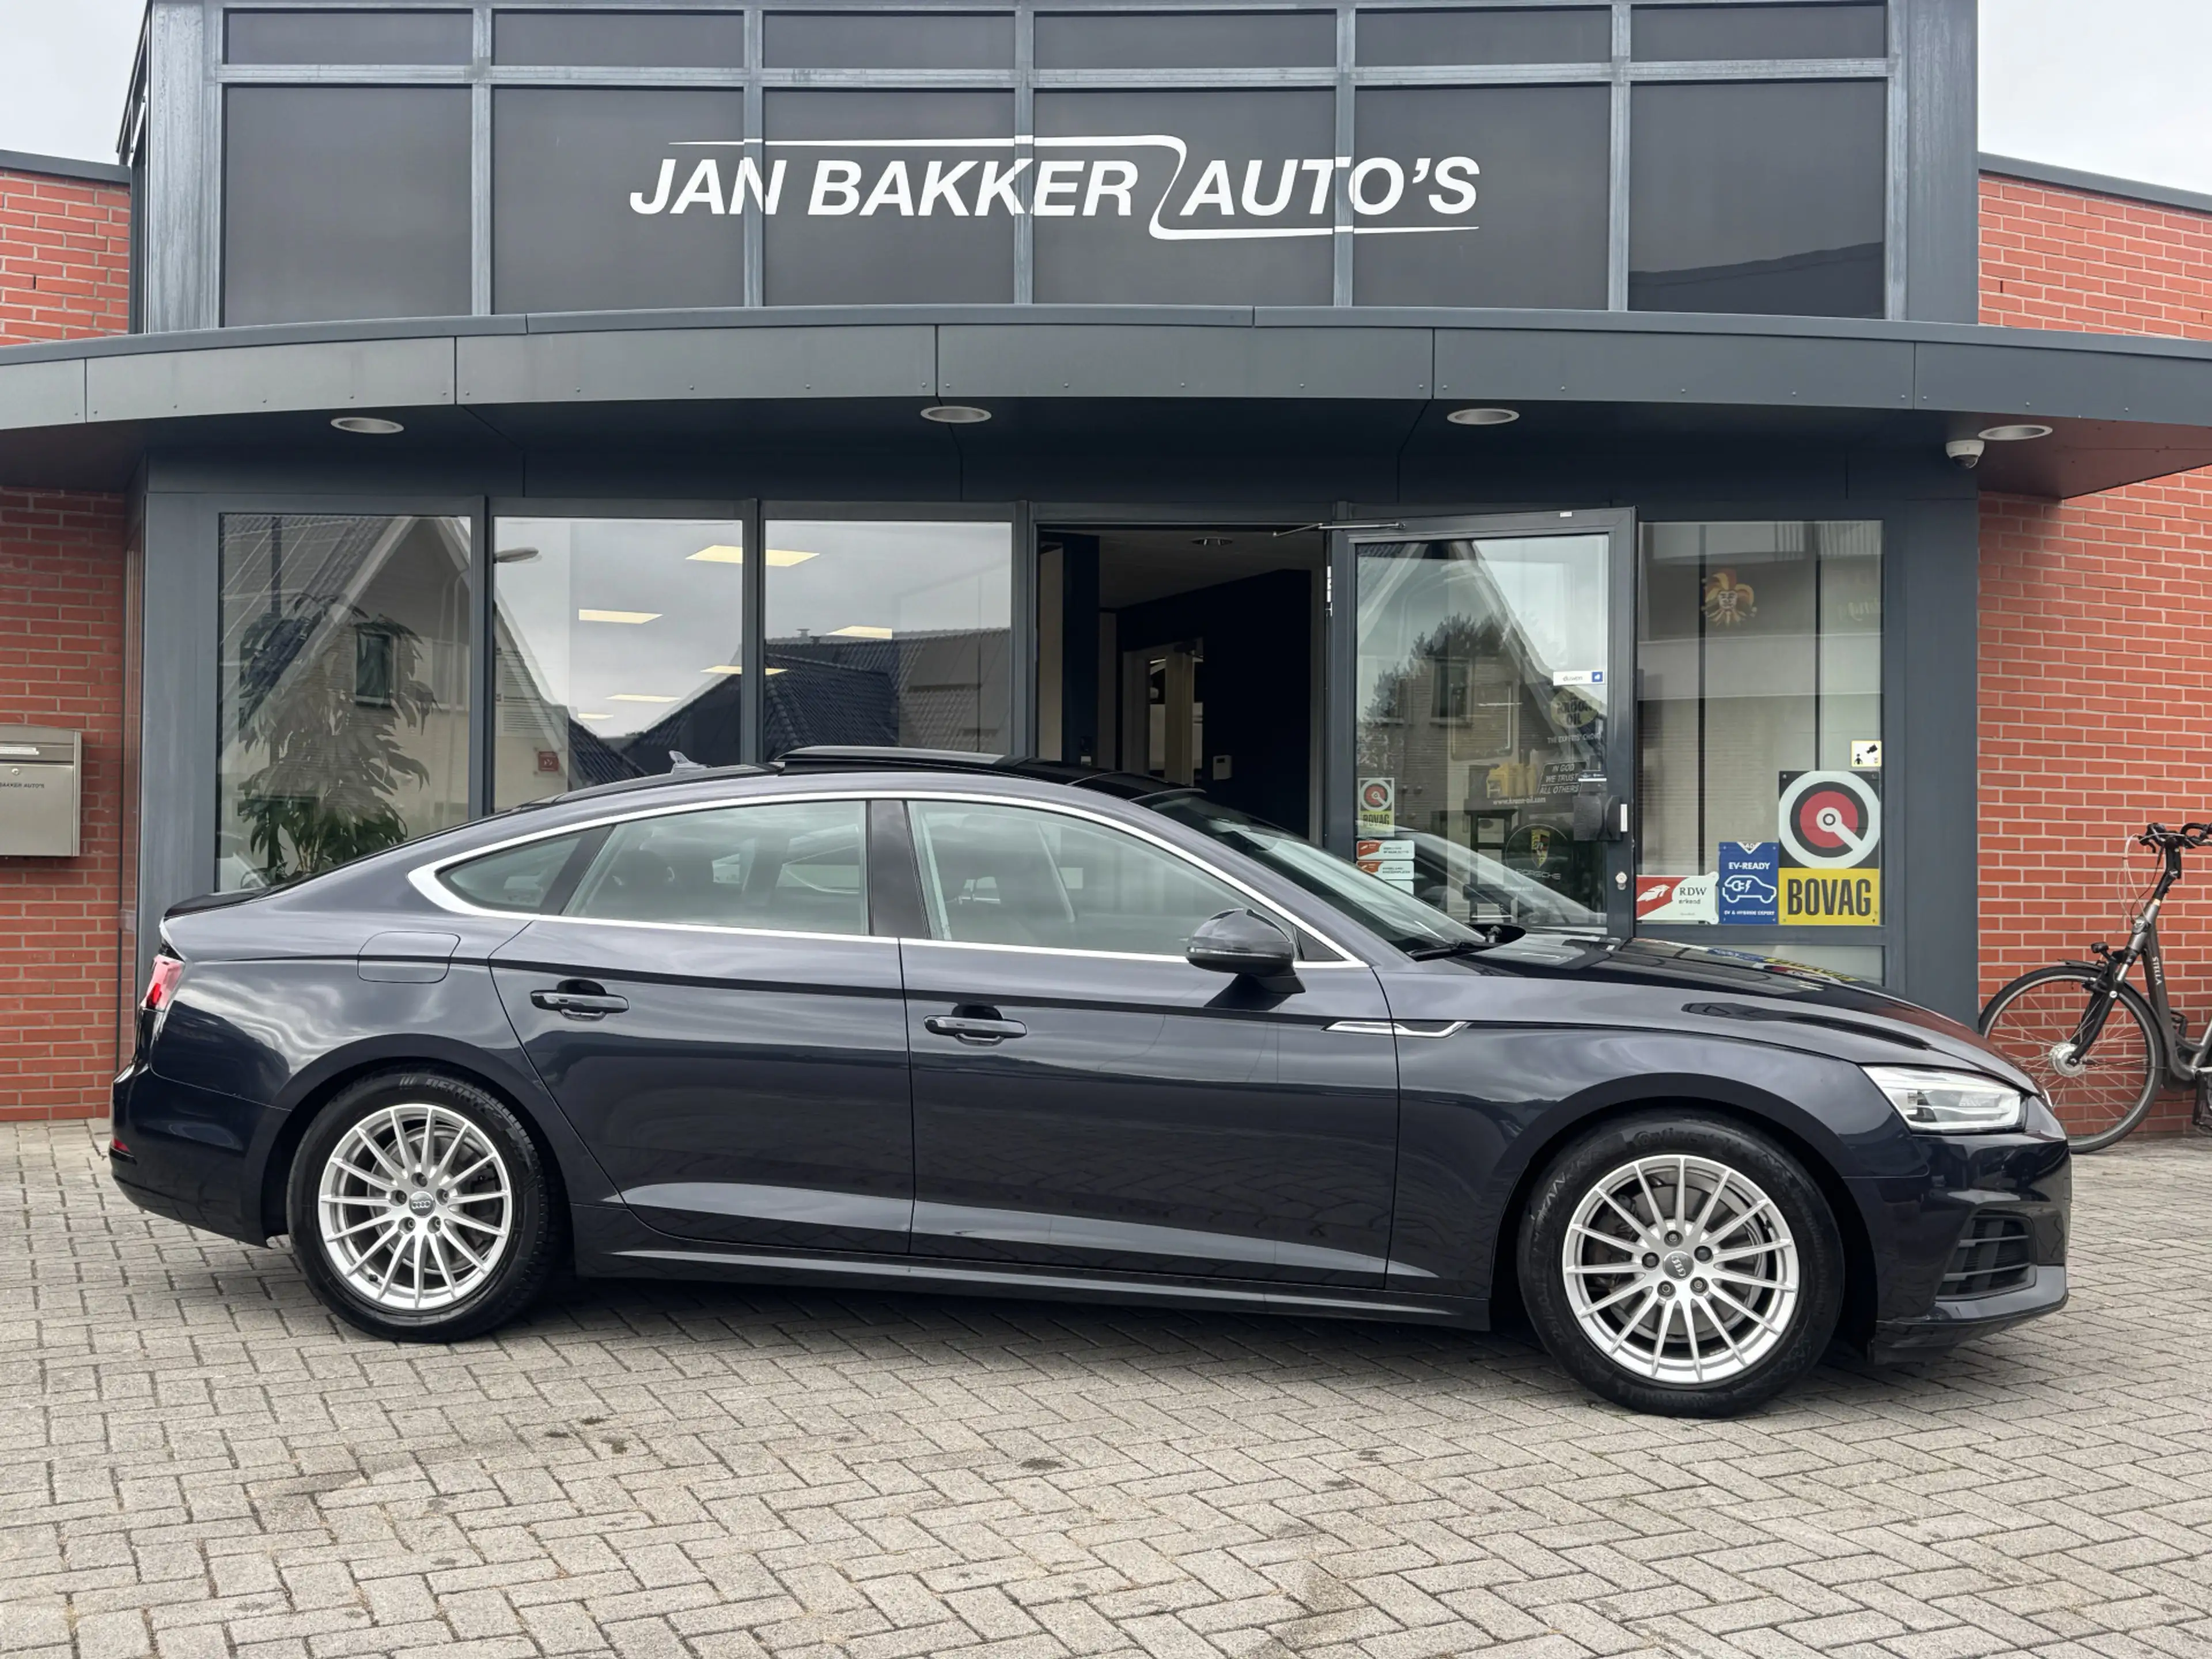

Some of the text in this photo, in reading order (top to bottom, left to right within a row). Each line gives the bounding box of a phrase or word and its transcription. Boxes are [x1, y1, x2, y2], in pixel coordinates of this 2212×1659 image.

[630, 156, 1480, 216] JAN BAKKER AUTO'S
[1729, 862, 1771, 870] EV-READY
[1679, 887, 1707, 896] RDW
[1787, 877, 1871, 917] BOVAG
[2152, 956, 2162, 986] STELLA
